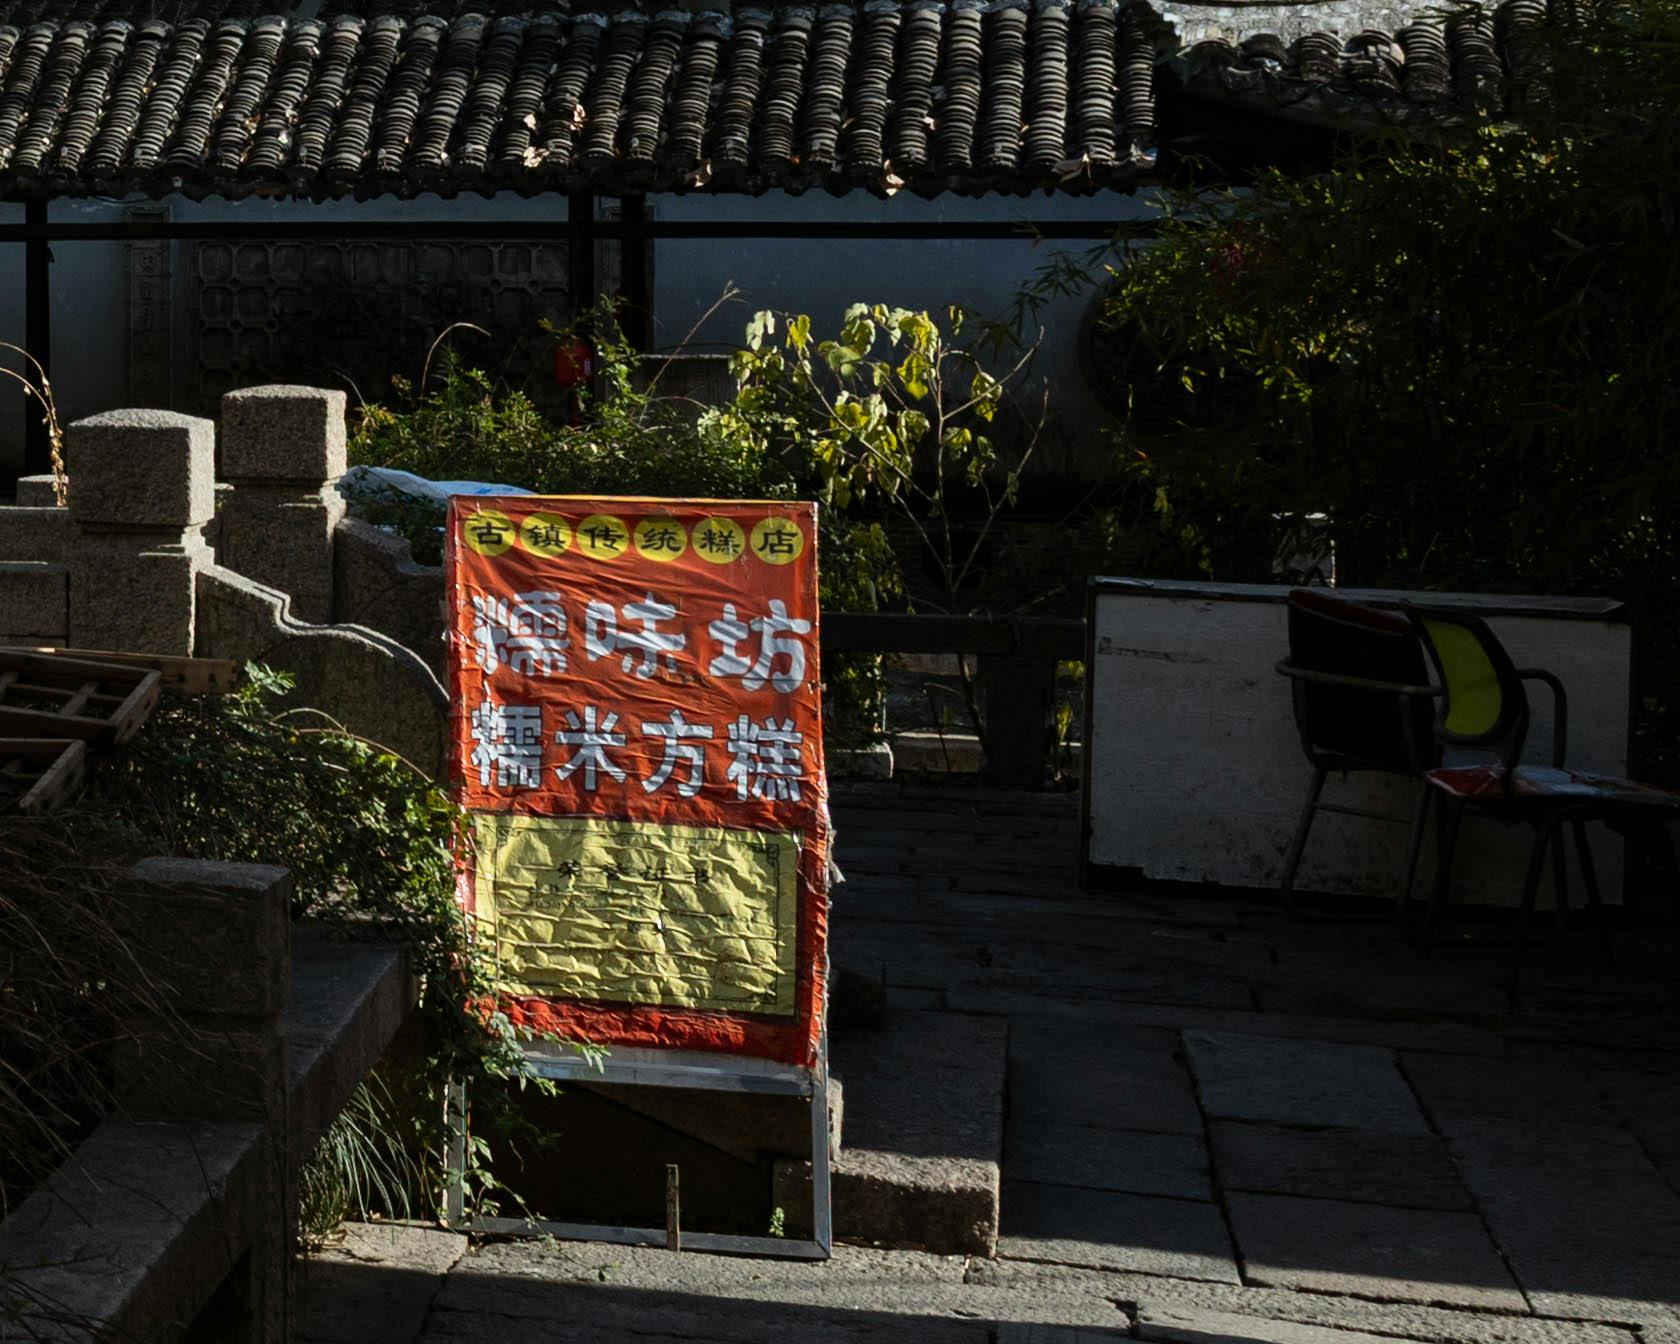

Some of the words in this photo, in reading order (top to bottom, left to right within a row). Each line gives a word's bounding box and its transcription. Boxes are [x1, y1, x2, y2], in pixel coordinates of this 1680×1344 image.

[472, 523, 798, 554] 古镇传统糕店
[471, 591, 811, 694] 糯味坊
[470, 700, 803, 803] 糯米方糕
